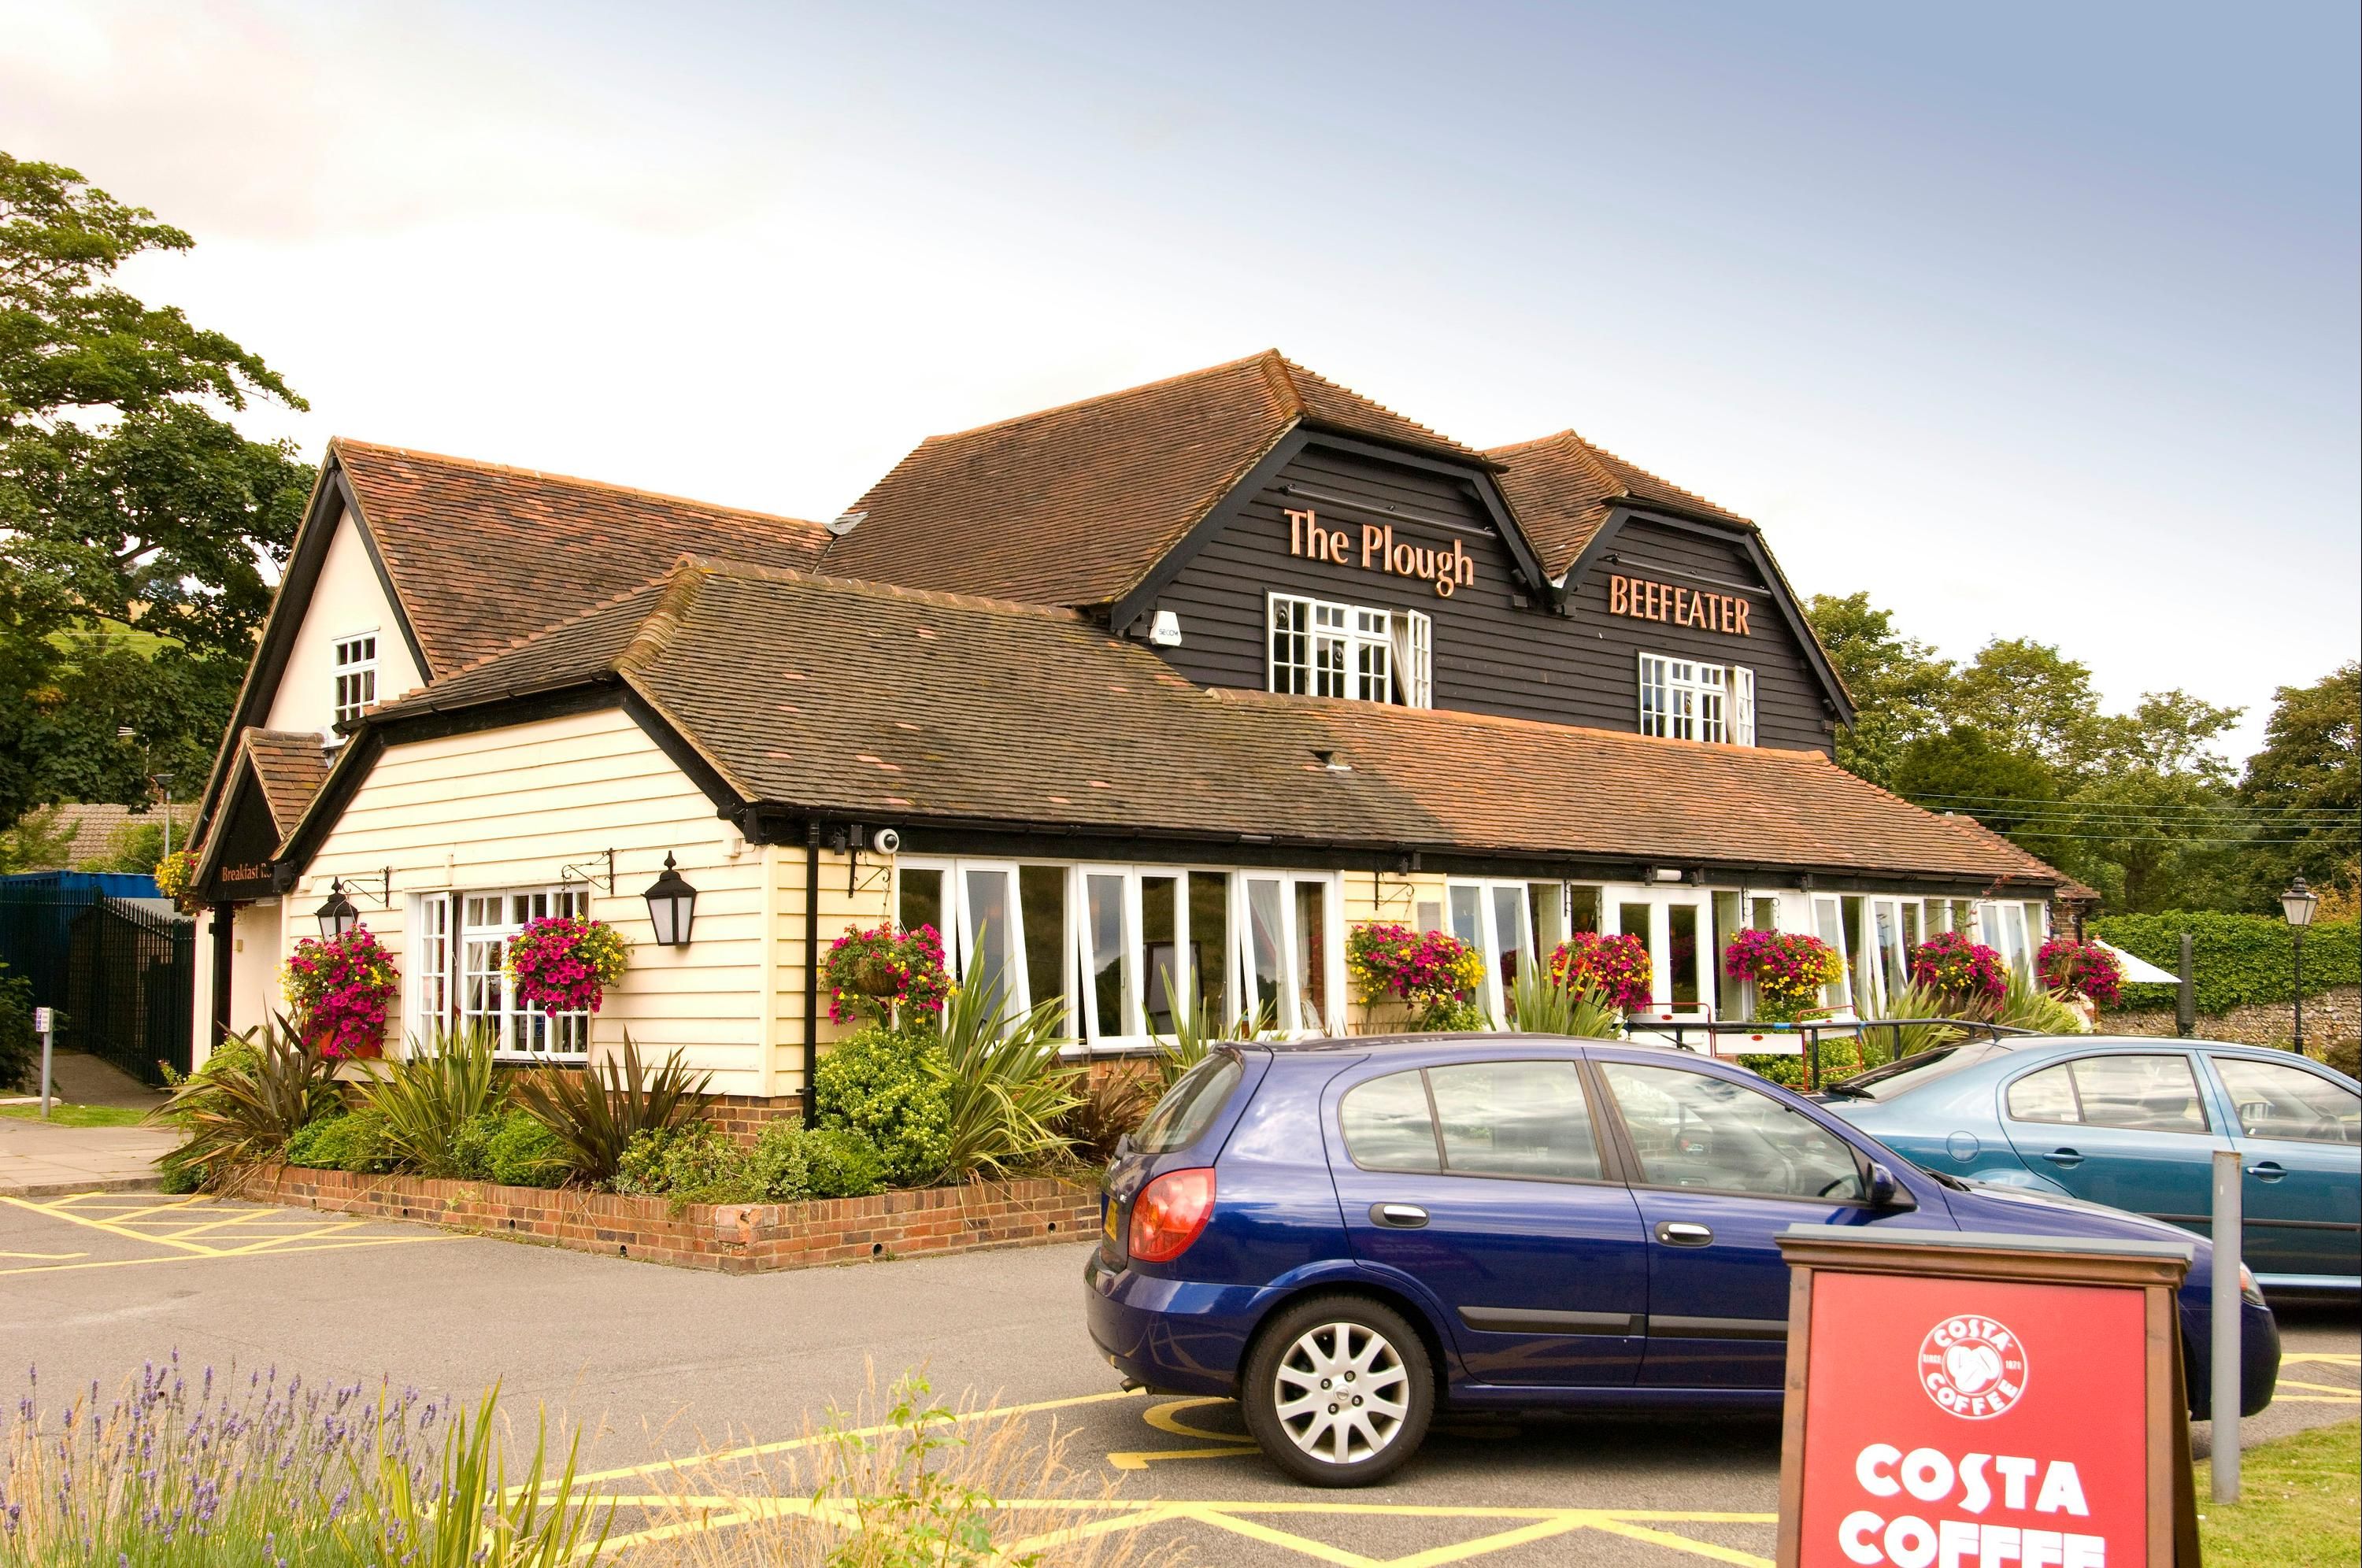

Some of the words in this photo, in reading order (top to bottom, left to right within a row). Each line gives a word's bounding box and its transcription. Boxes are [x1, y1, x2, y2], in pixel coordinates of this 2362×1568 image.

[1283, 508, 1349, 564] The
[1362, 523, 1474, 597] Plough
[1610, 575, 1750, 635] BEEFEATER
[222, 863, 258, 881] Breakfast
[1934, 1318, 2010, 1352] COSTA
[1927, 1372, 2020, 1415] COFFEE
[1855, 1443, 2090, 1514] COSTA
